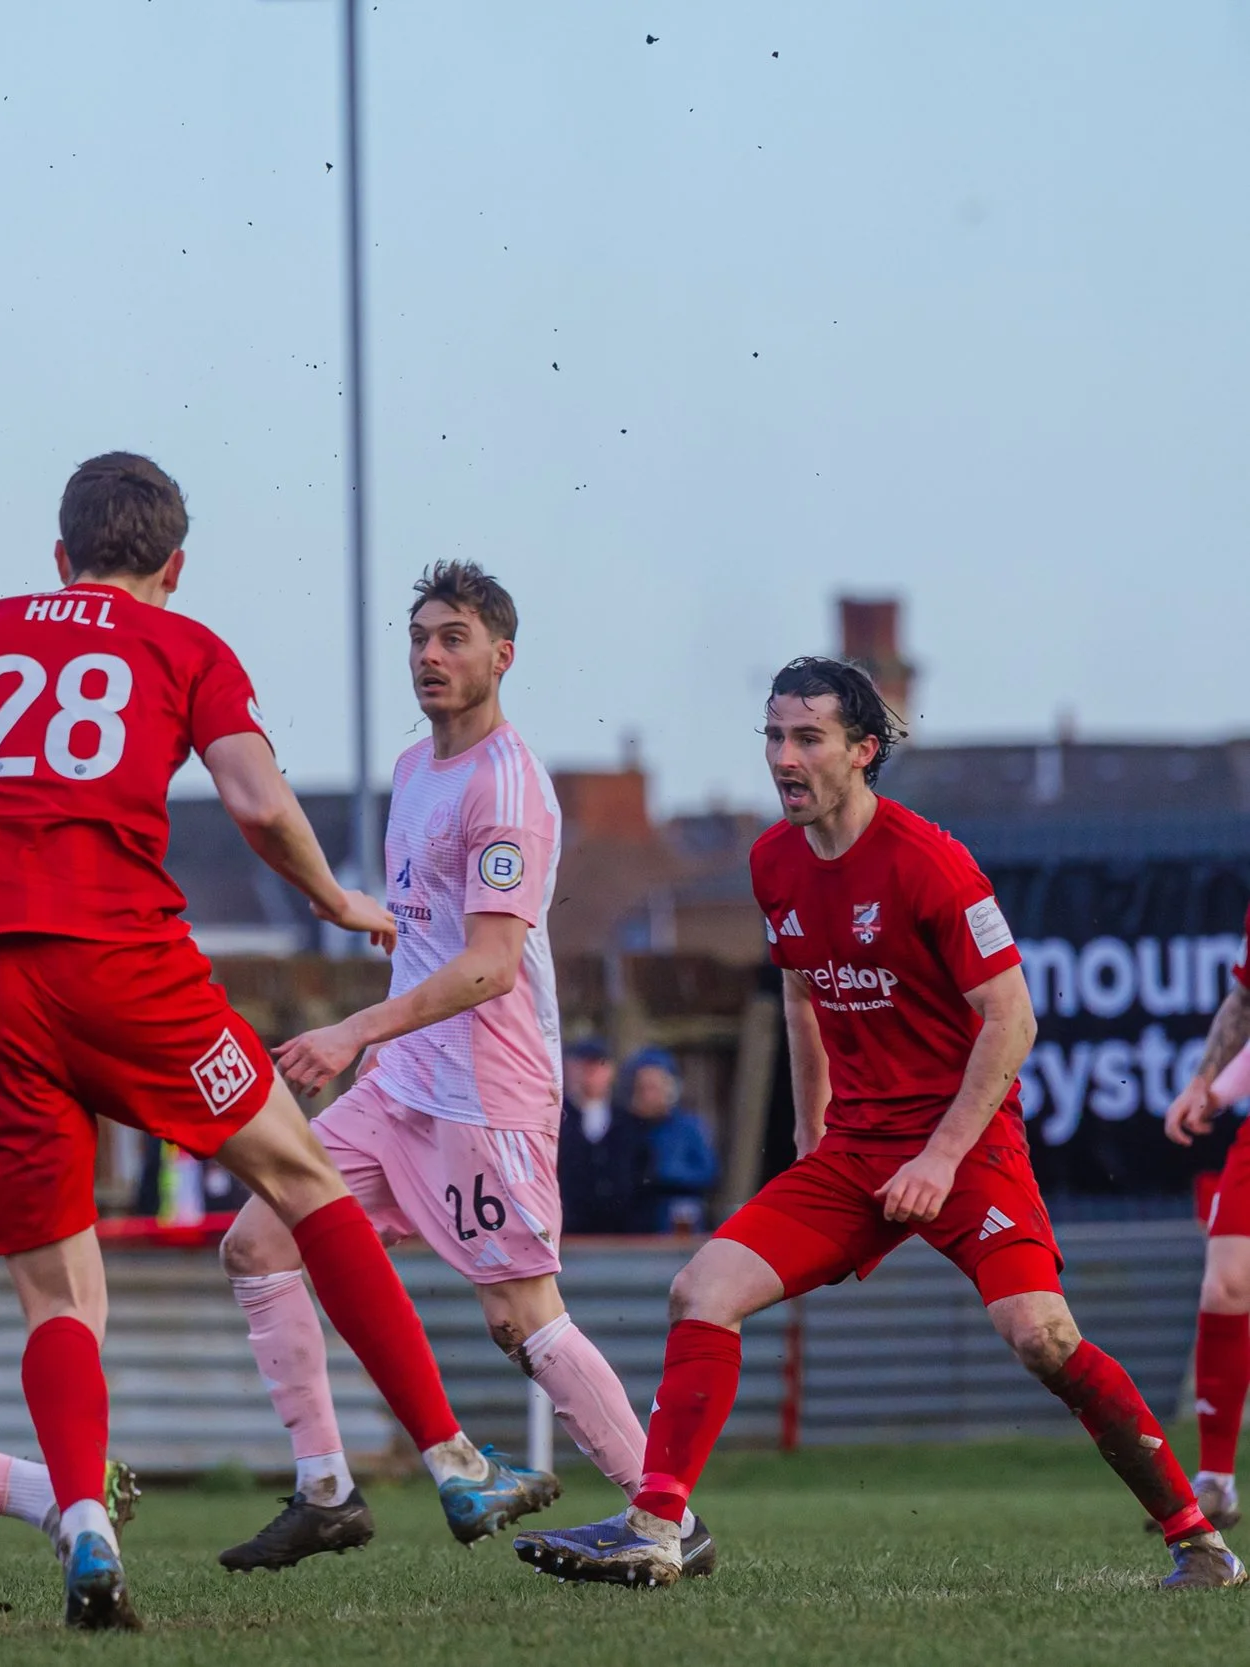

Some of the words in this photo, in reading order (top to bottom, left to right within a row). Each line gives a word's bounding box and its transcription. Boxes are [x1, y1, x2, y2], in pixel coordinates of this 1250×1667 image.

[25, 600, 116, 630] HULL
[493, 857, 513, 876] B
[1018, 1024, 1250, 1146] syste
[445, 1173, 506, 1242] 26
